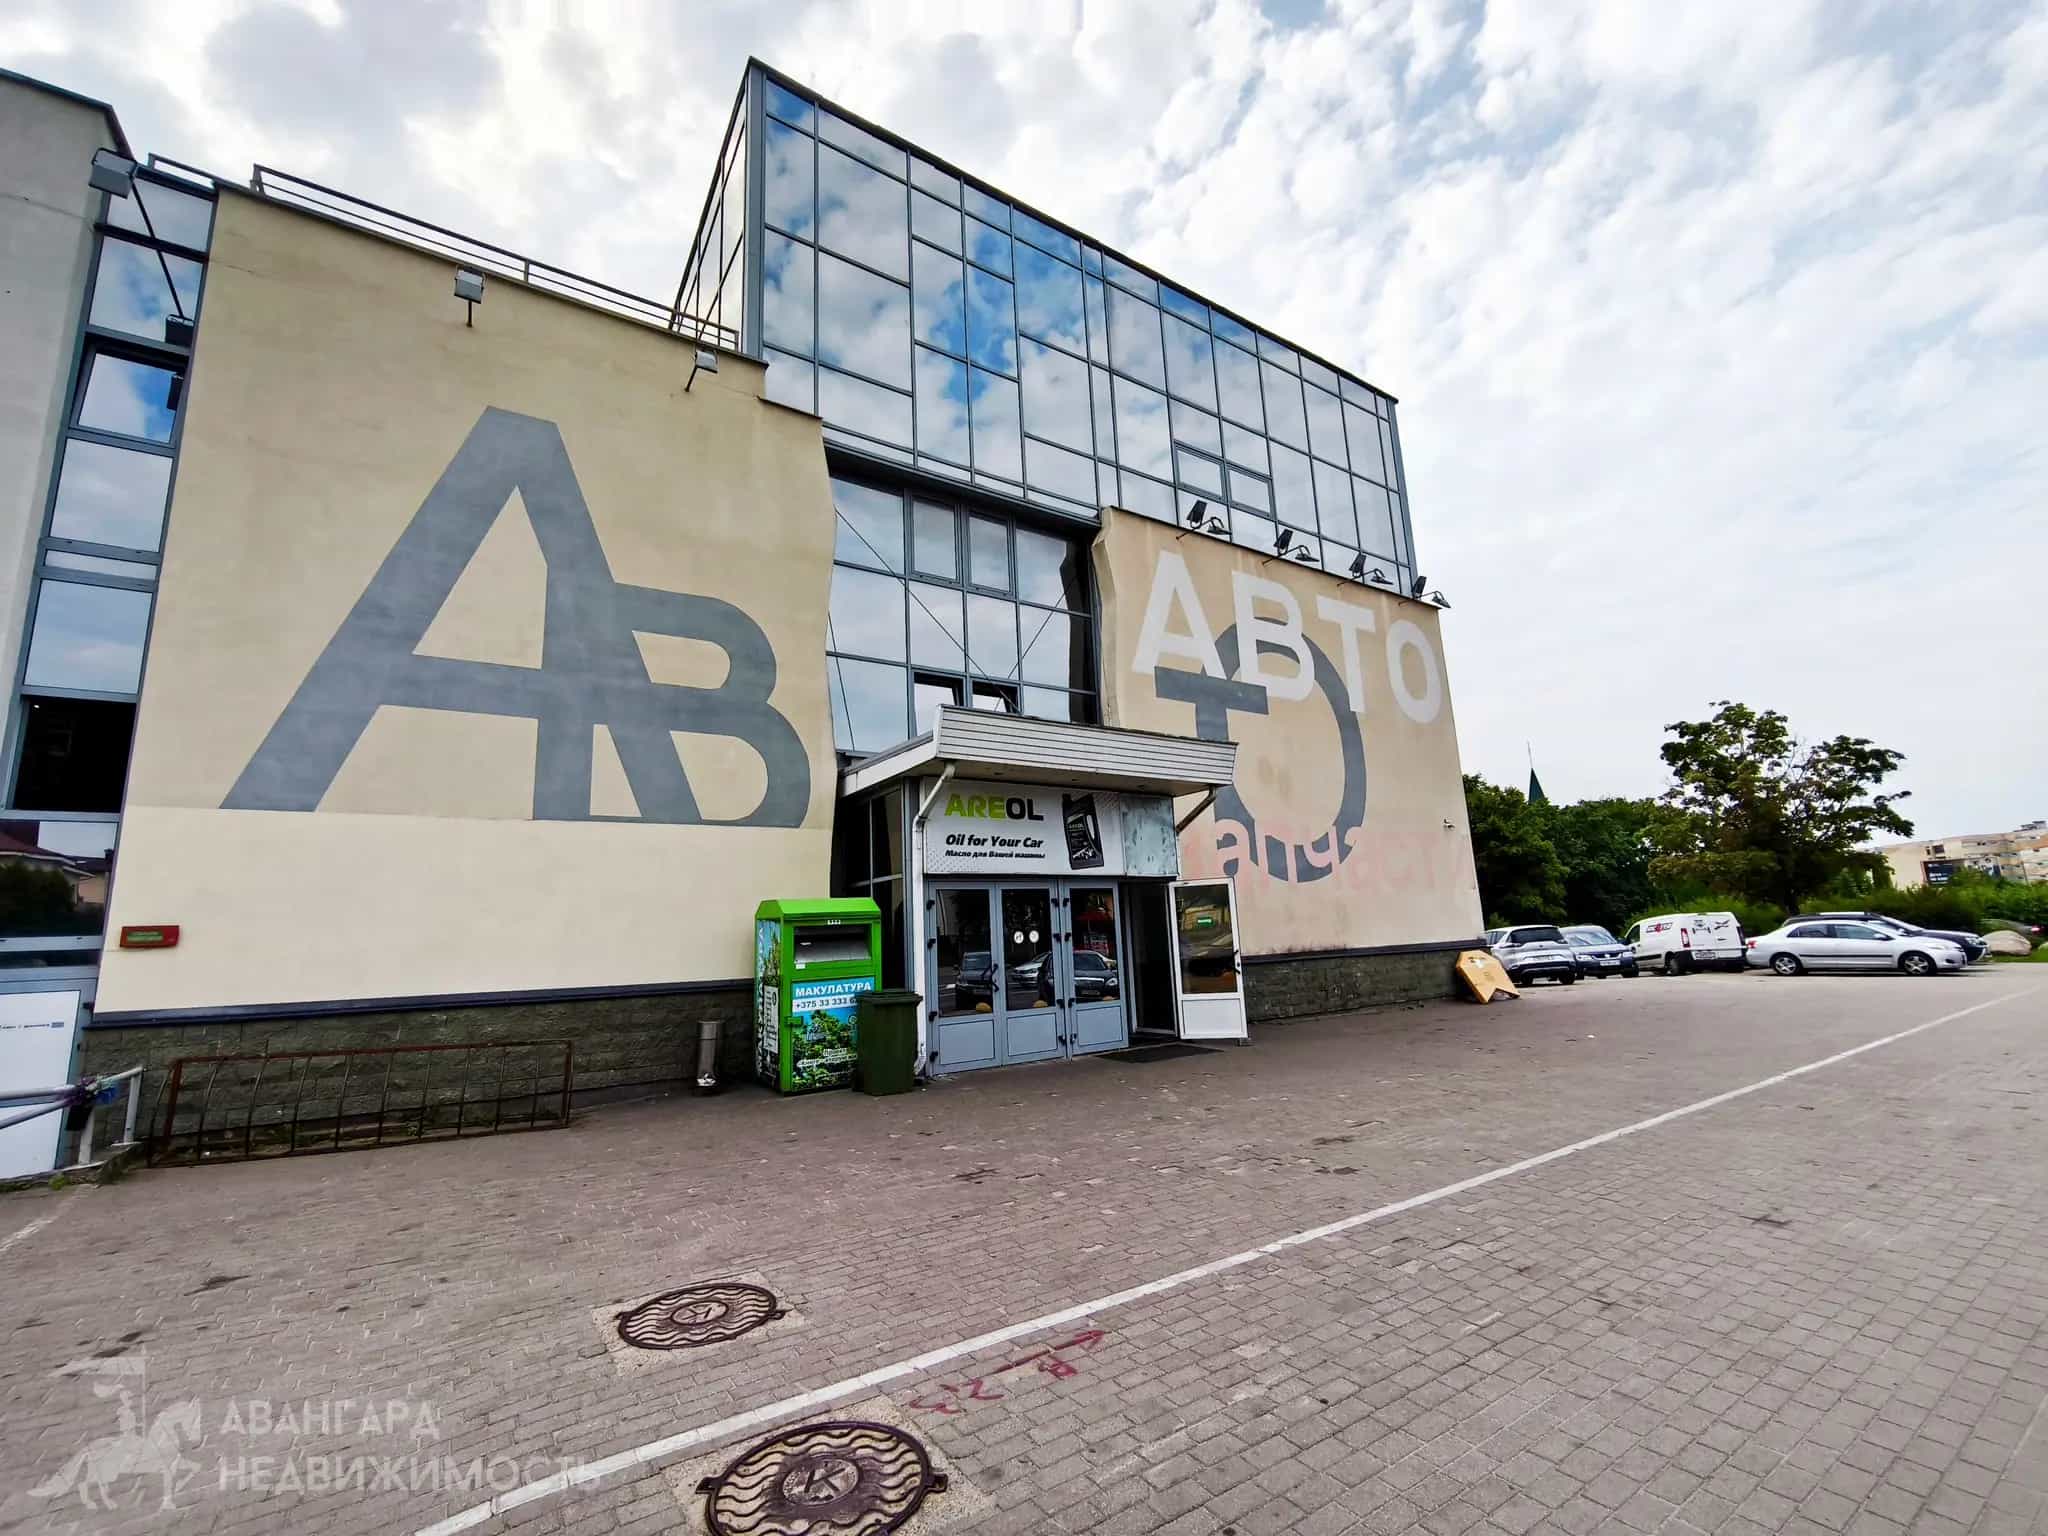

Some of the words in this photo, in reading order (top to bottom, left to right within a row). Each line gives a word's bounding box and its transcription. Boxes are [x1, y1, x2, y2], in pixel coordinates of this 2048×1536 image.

[1132, 549, 1442, 724] АВТО
[945, 794, 1044, 821] AREOL
[945, 834, 966, 846] Oil
[967, 834, 988, 846] for
[991, 836, 1021, 847] Your
[1023, 837, 1043, 848] Car
[945, 849, 971, 857] Масло
[795, 982, 872, 997] МАКУЛАТУРА
